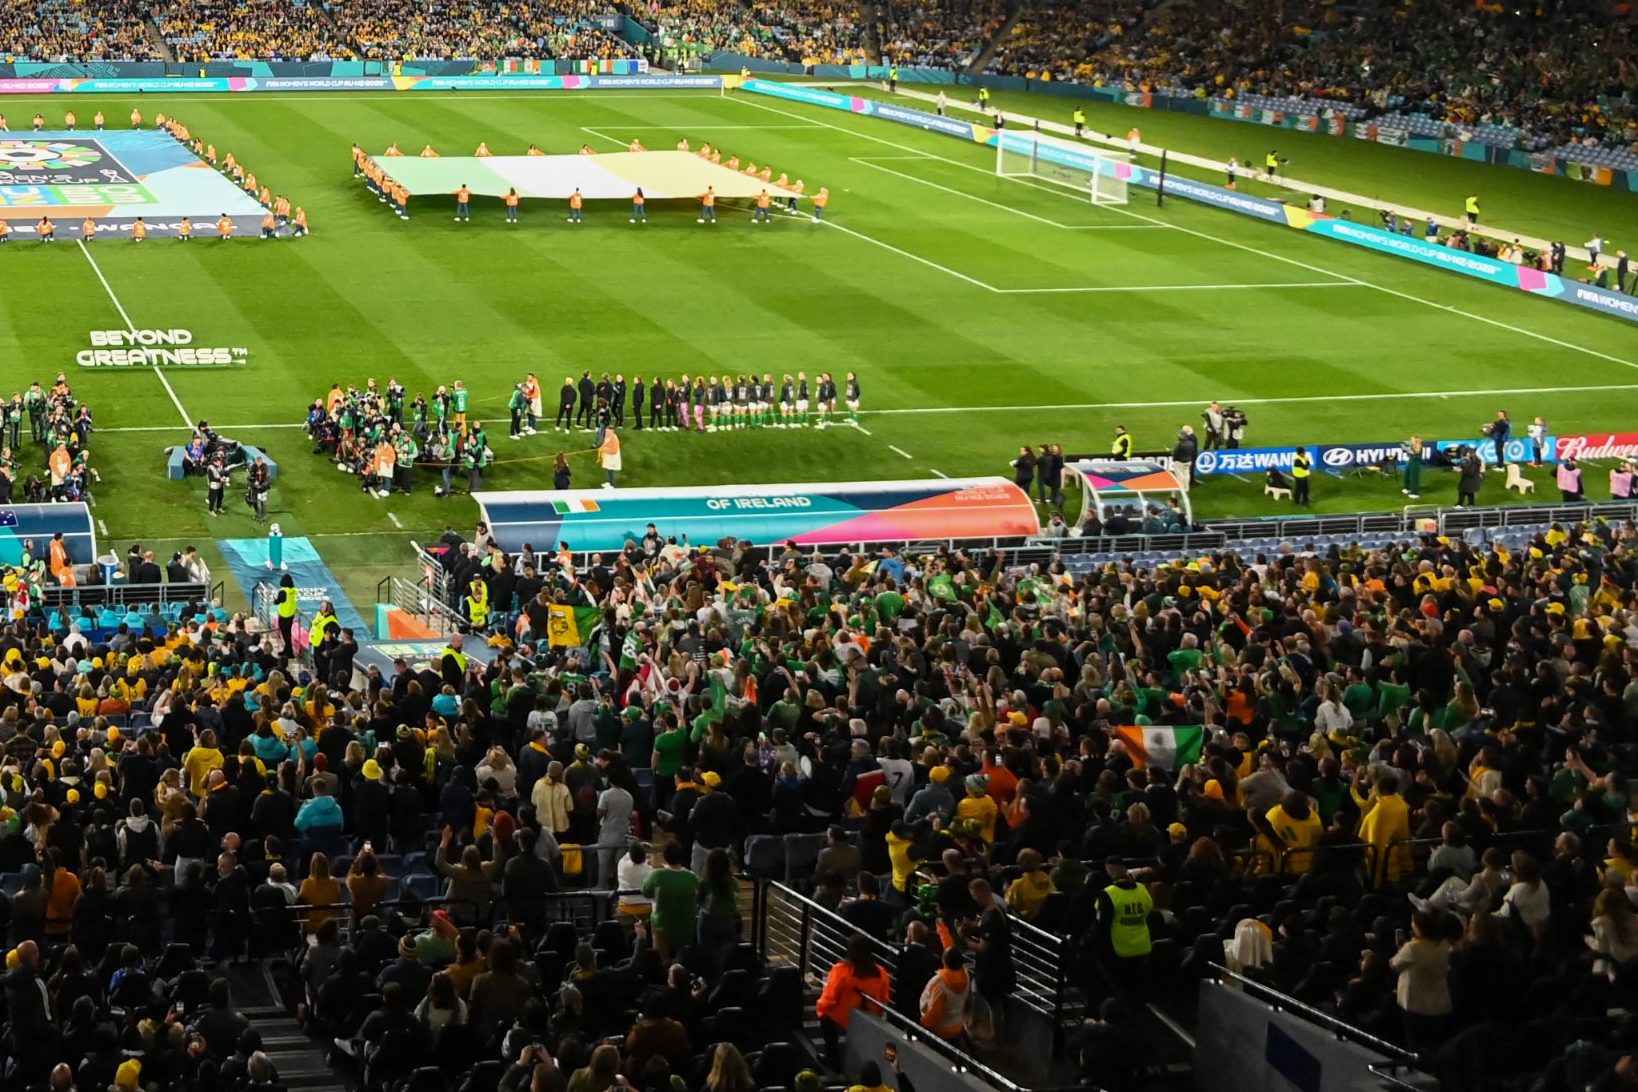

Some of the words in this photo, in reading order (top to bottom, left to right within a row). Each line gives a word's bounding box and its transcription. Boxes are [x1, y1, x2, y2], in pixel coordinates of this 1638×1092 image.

[1577, 289, 1599, 304] FIFA
[90, 329, 192, 347] BEYOND
[1356, 447, 1431, 463] HYUNI
[706, 498, 730, 510] OF
[735, 496, 811, 509] IRELAND
